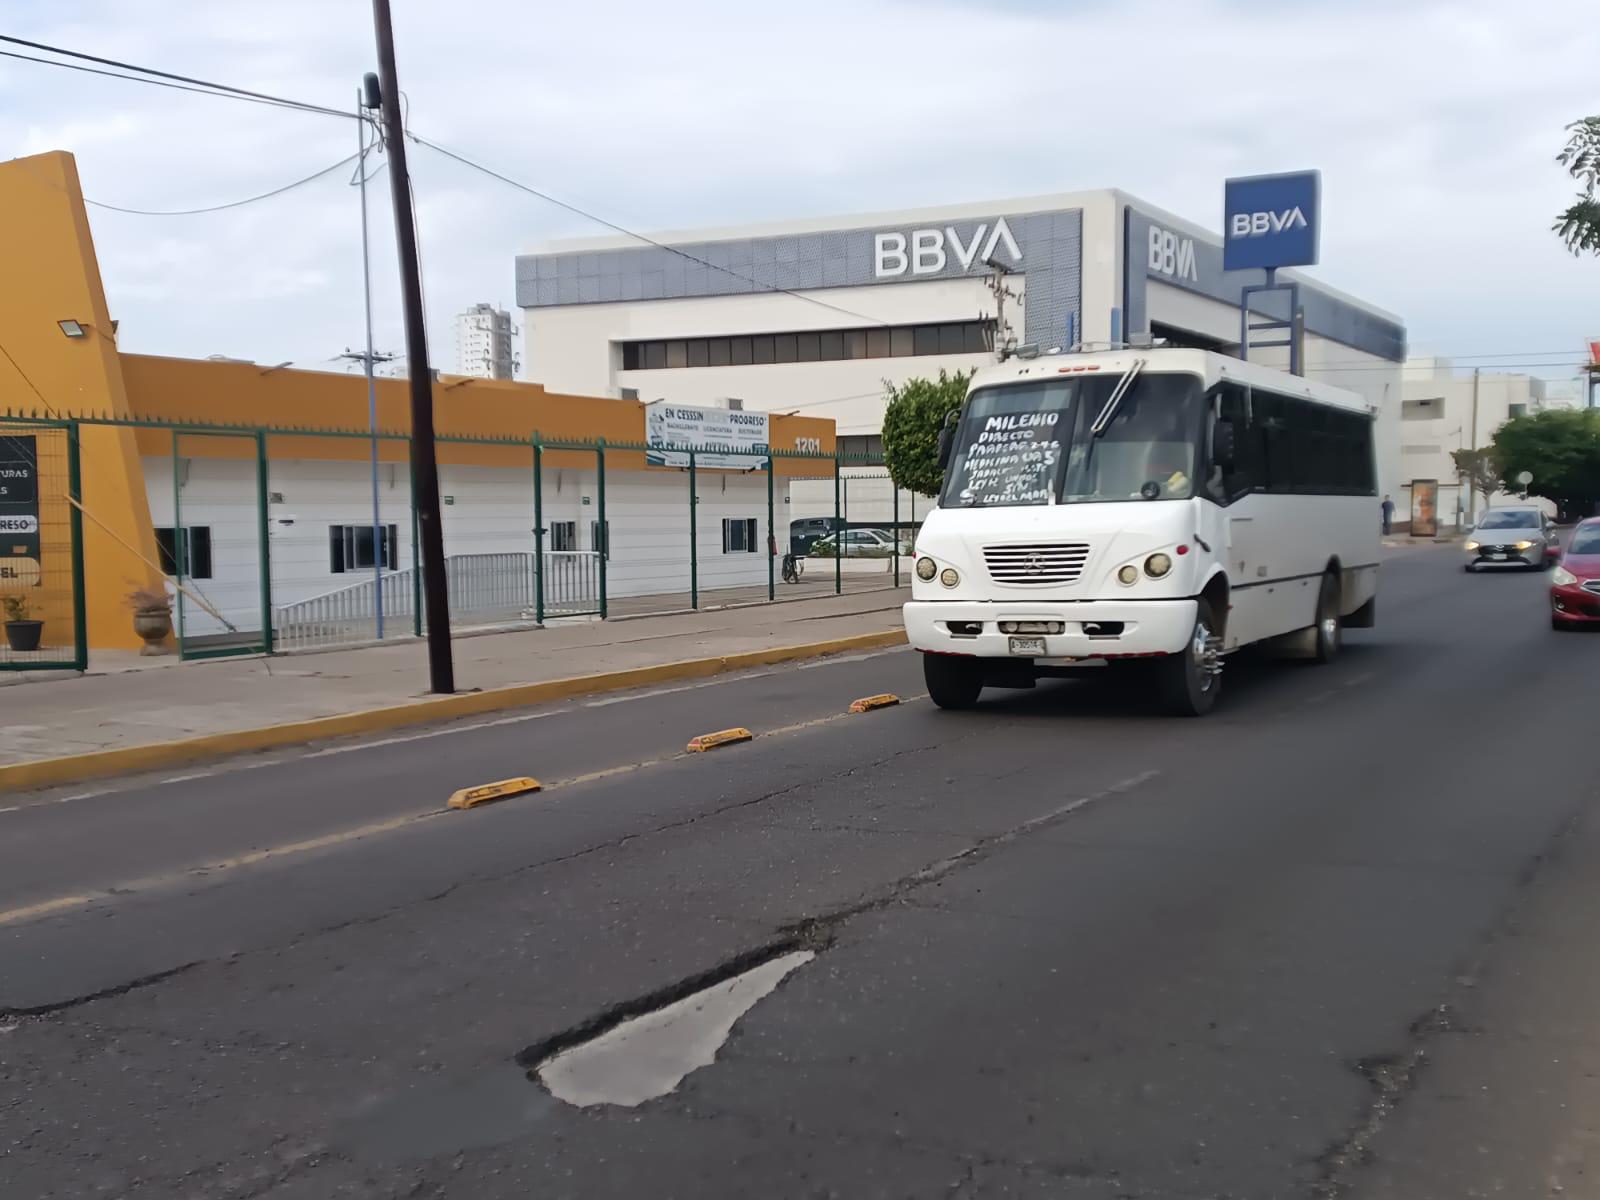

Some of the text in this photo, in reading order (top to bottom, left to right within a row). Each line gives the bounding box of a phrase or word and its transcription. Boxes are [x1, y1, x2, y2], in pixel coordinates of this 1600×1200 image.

[1231, 206, 1308, 237] BBVA
[874, 215, 1023, 277] BBVA
[1148, 225, 1198, 282] BBVA
[664, 407, 675, 418] EN
[985, 413, 1059, 431] MILENIO
[795, 436, 821, 455] 1201
